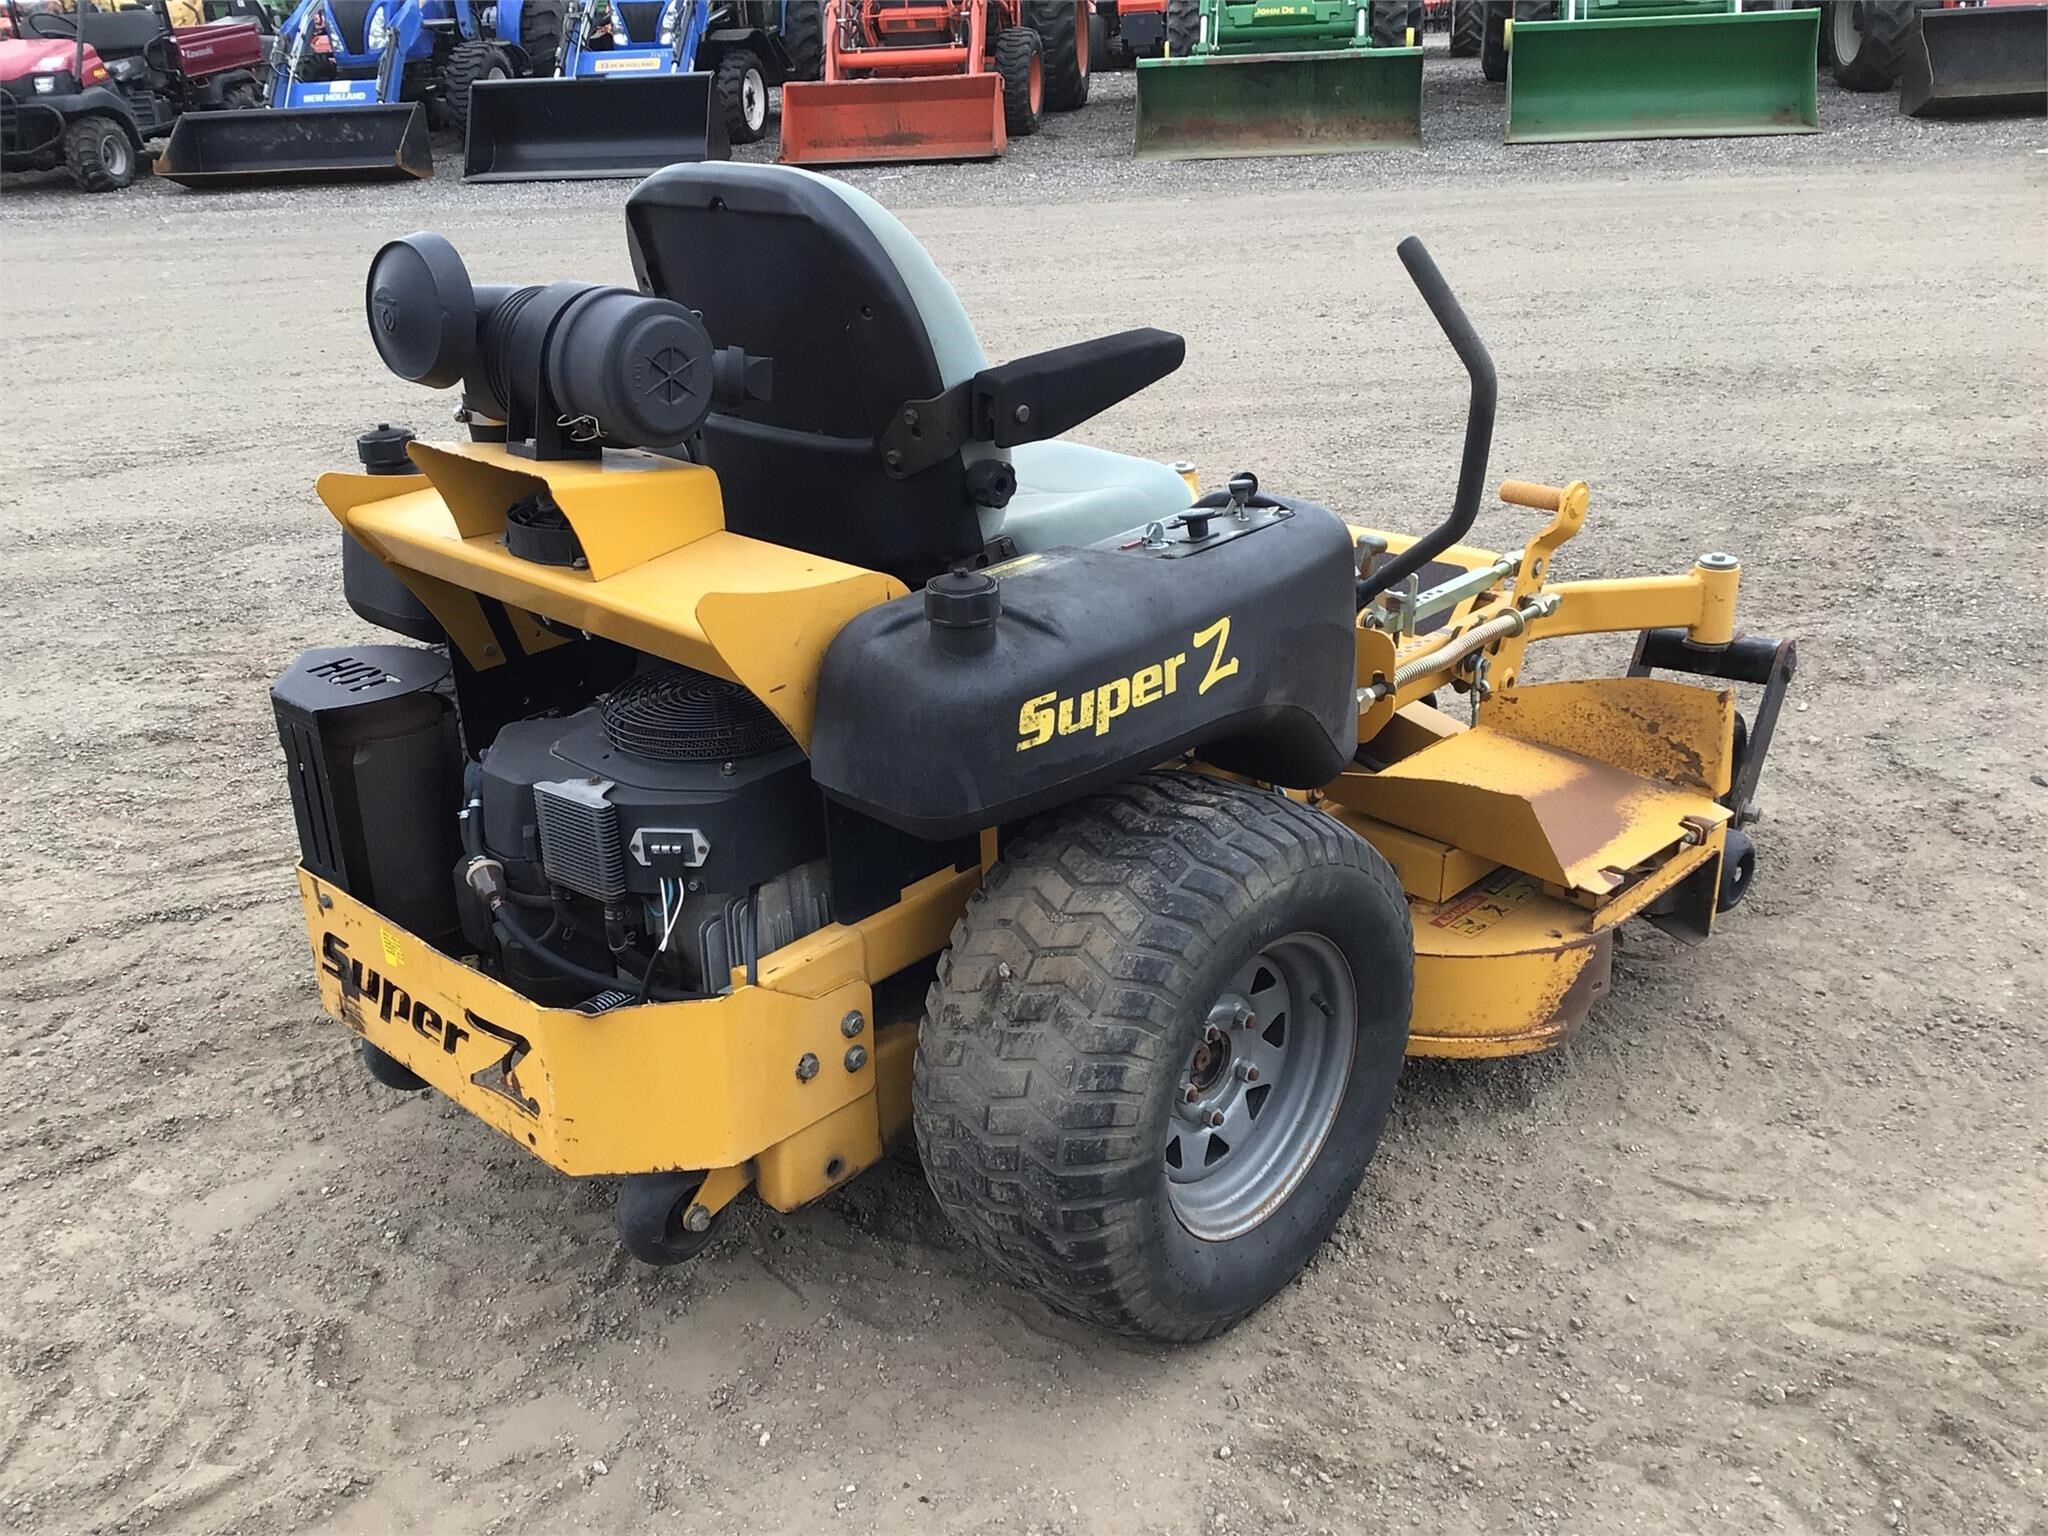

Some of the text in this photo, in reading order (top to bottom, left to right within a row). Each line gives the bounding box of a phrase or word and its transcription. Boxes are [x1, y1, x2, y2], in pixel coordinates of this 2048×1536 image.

[1255, 7, 1280, 15] JOHN
[186, 46, 214, 58] Kawasaki
[303, 92, 366, 103] NEW HOLLAND
[1016, 616, 1240, 752] Super Z
[322, 931, 541, 1120] Super Z
